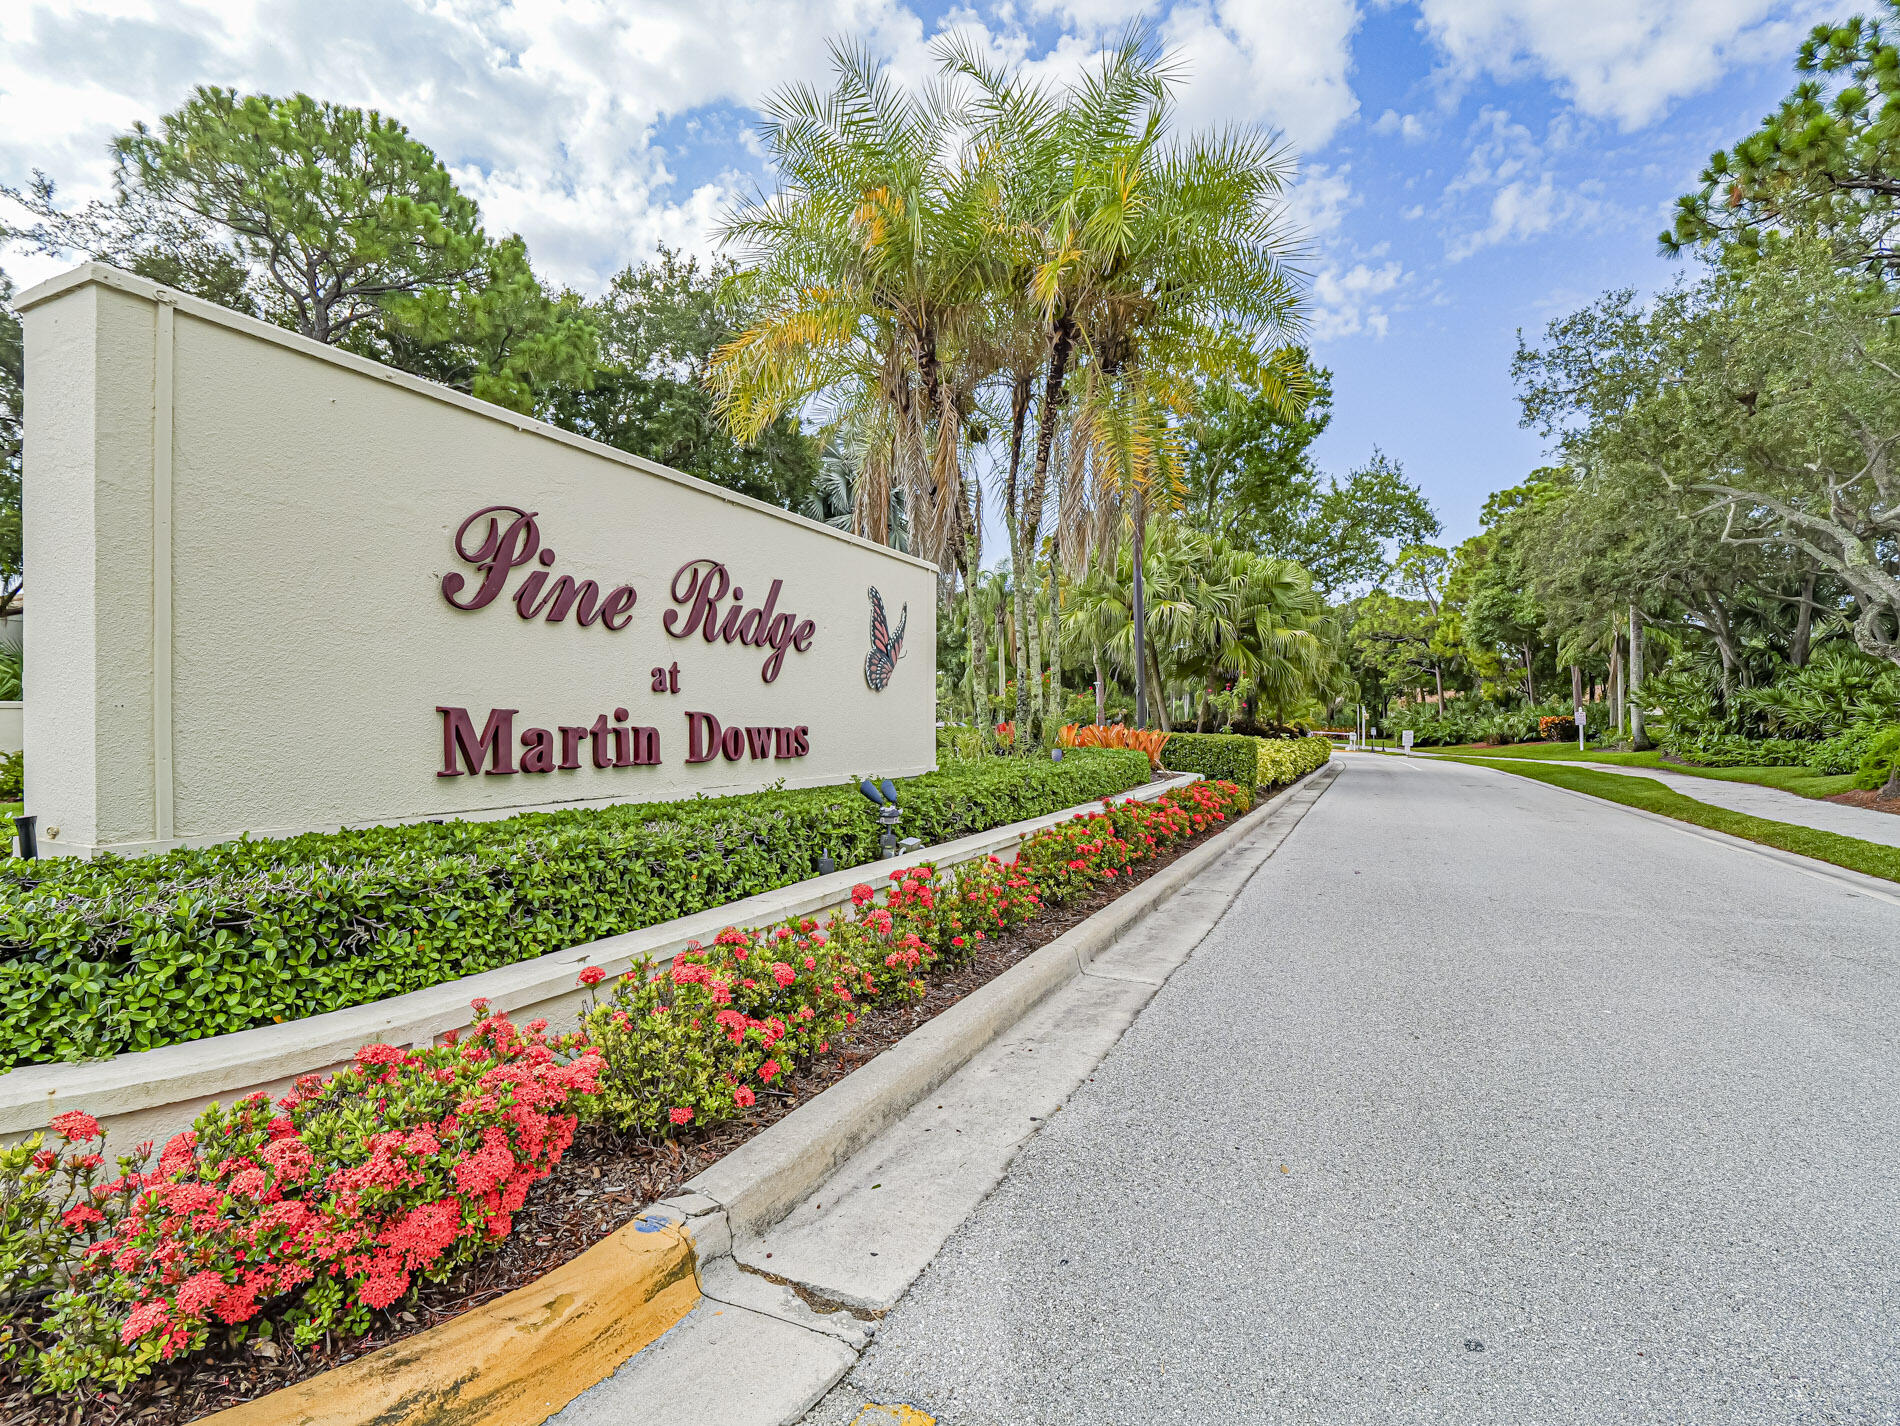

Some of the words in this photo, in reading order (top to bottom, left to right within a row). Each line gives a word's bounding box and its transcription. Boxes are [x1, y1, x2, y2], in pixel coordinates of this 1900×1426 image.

[442, 505, 637, 631] Pine
[663, 558, 816, 684] Ridge
[651, 661, 681, 694] at
[436, 706, 662, 778] Martin
[684, 711, 809, 764] Downs
